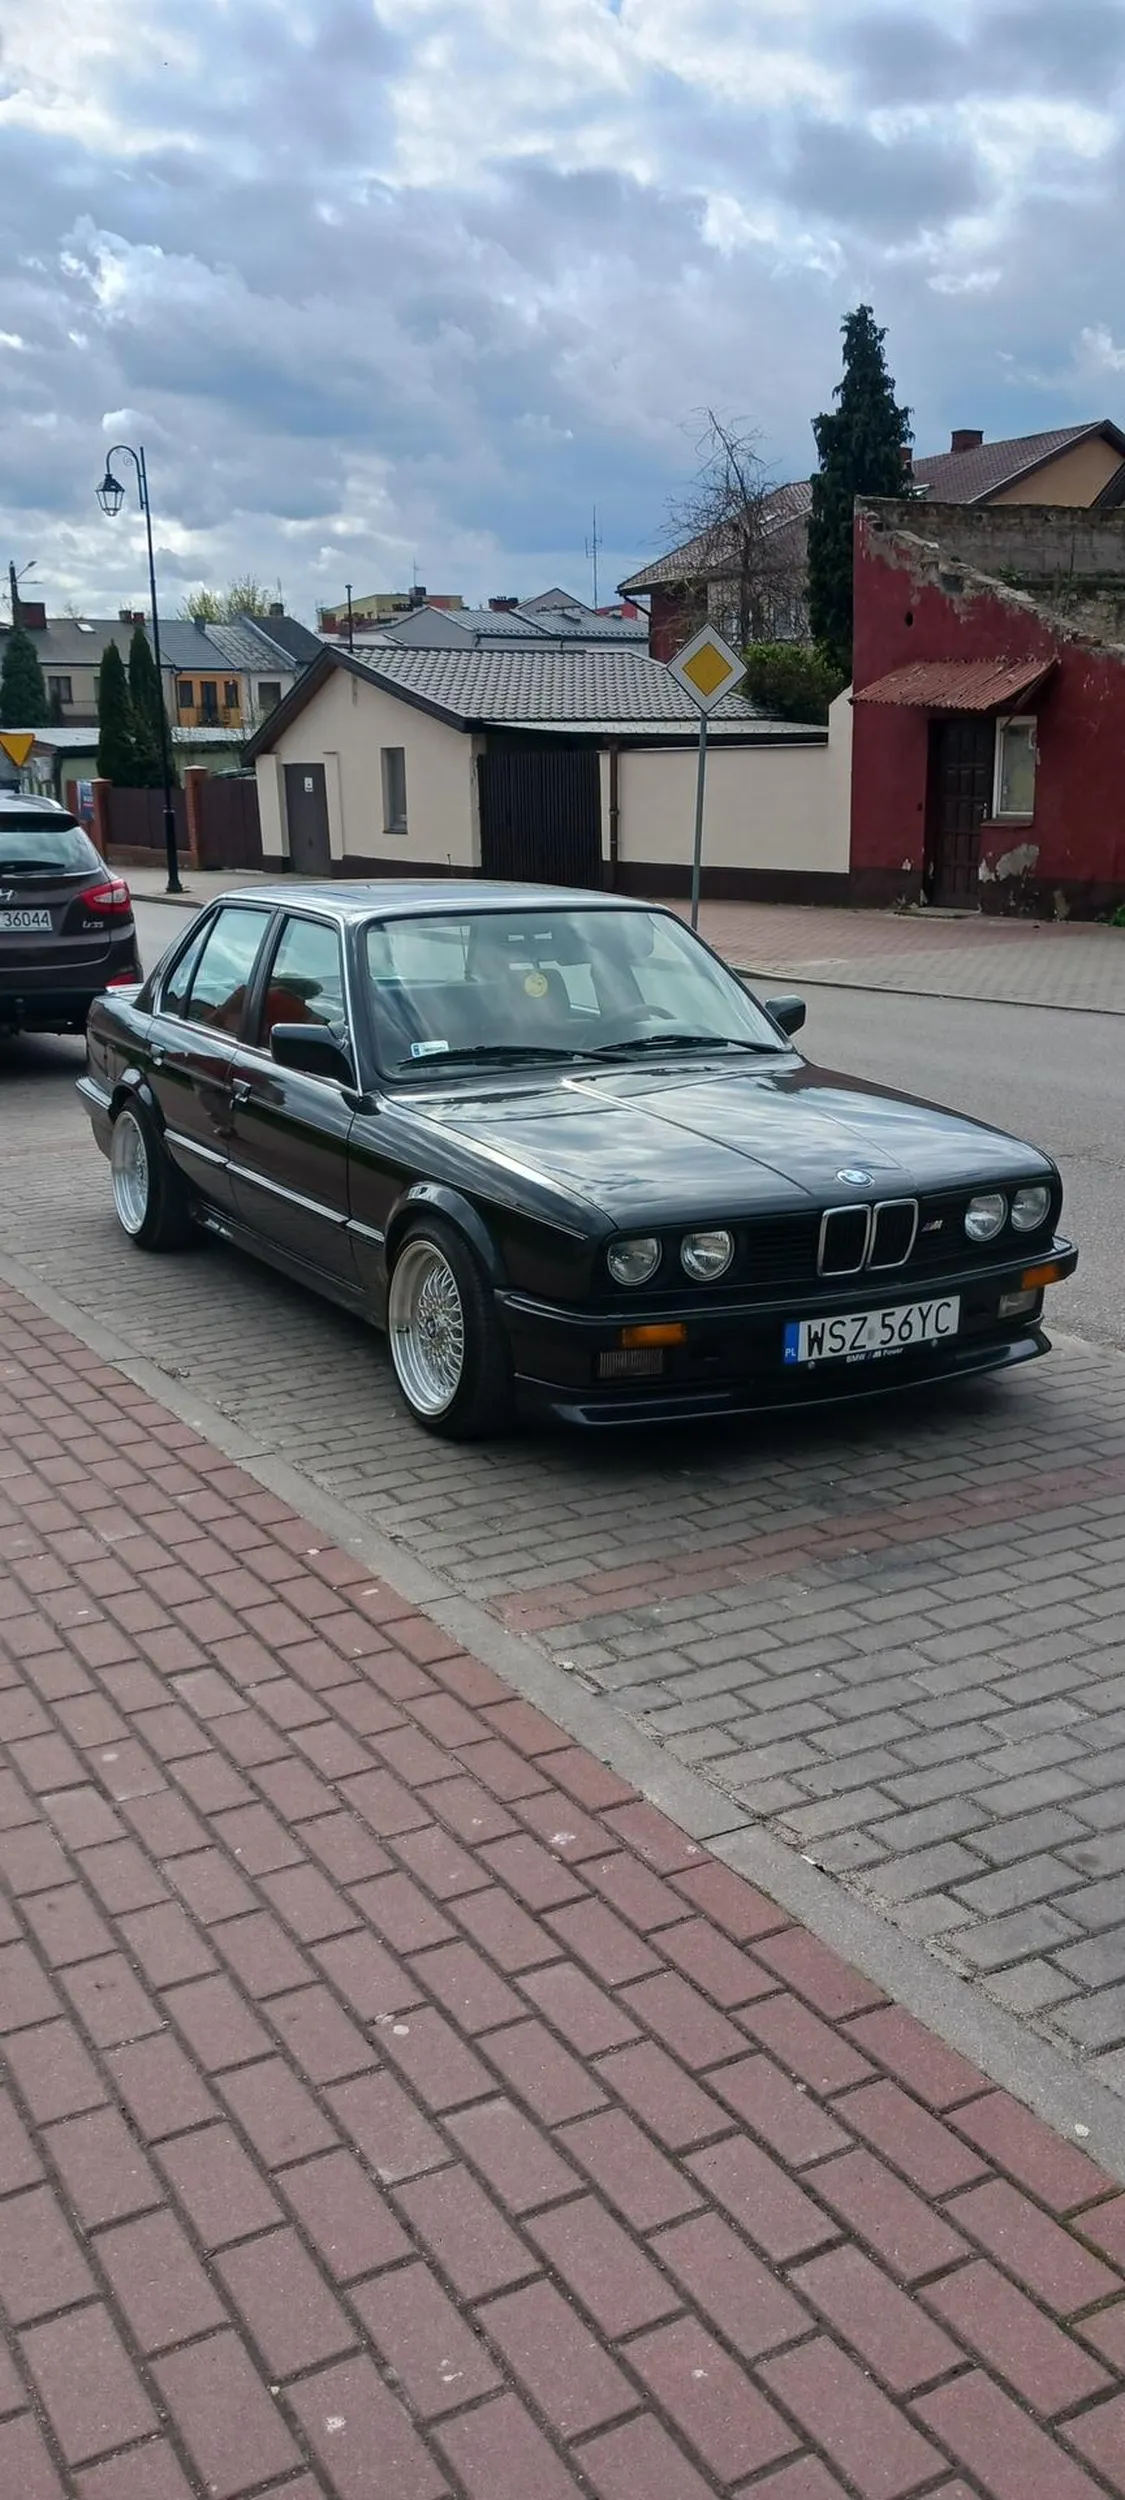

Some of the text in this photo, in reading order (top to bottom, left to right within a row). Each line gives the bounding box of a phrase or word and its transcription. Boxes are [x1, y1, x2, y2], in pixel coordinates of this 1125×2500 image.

[4, 911, 50, 927] 36044
[807, 1302, 952, 1357] WSZ 56YC
[784, 1348, 797, 1358] PL
[846, 1352, 866, 1363] BMW
